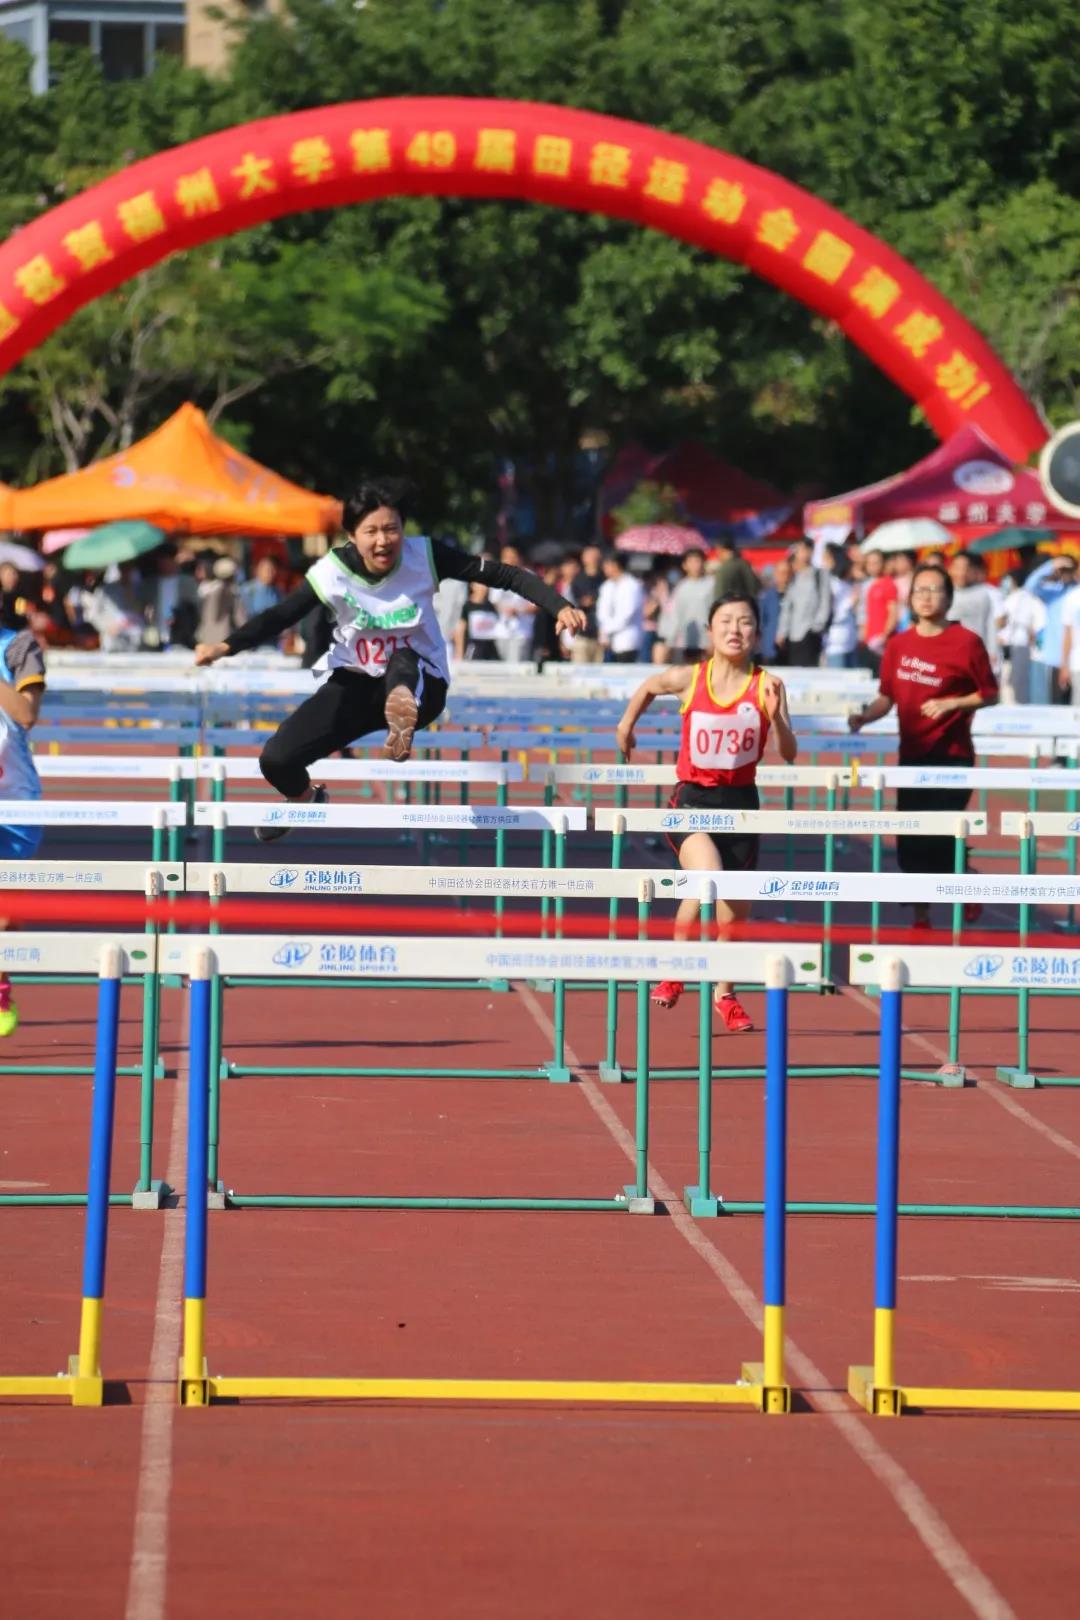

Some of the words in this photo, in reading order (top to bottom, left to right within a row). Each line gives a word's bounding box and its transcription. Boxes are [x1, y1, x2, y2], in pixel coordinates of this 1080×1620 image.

[696, 728, 755, 754] 0736
[688, 813, 735, 826] 金陵体育
[0, 871, 103, 884] 径器材类官方唯一供应商
[304, 870, 361, 885] 金陵体育
[428, 877, 595, 891] 中国田径协会田径器材类官方唯一供应商
[332, 885, 363, 893] SPORTS
[791, 880, 841, 892] 金陵体育
[320, 943, 397, 963] 金陵体育
[318, 963, 356, 971] JINLING
[359, 964, 399, 973] SPORTS
